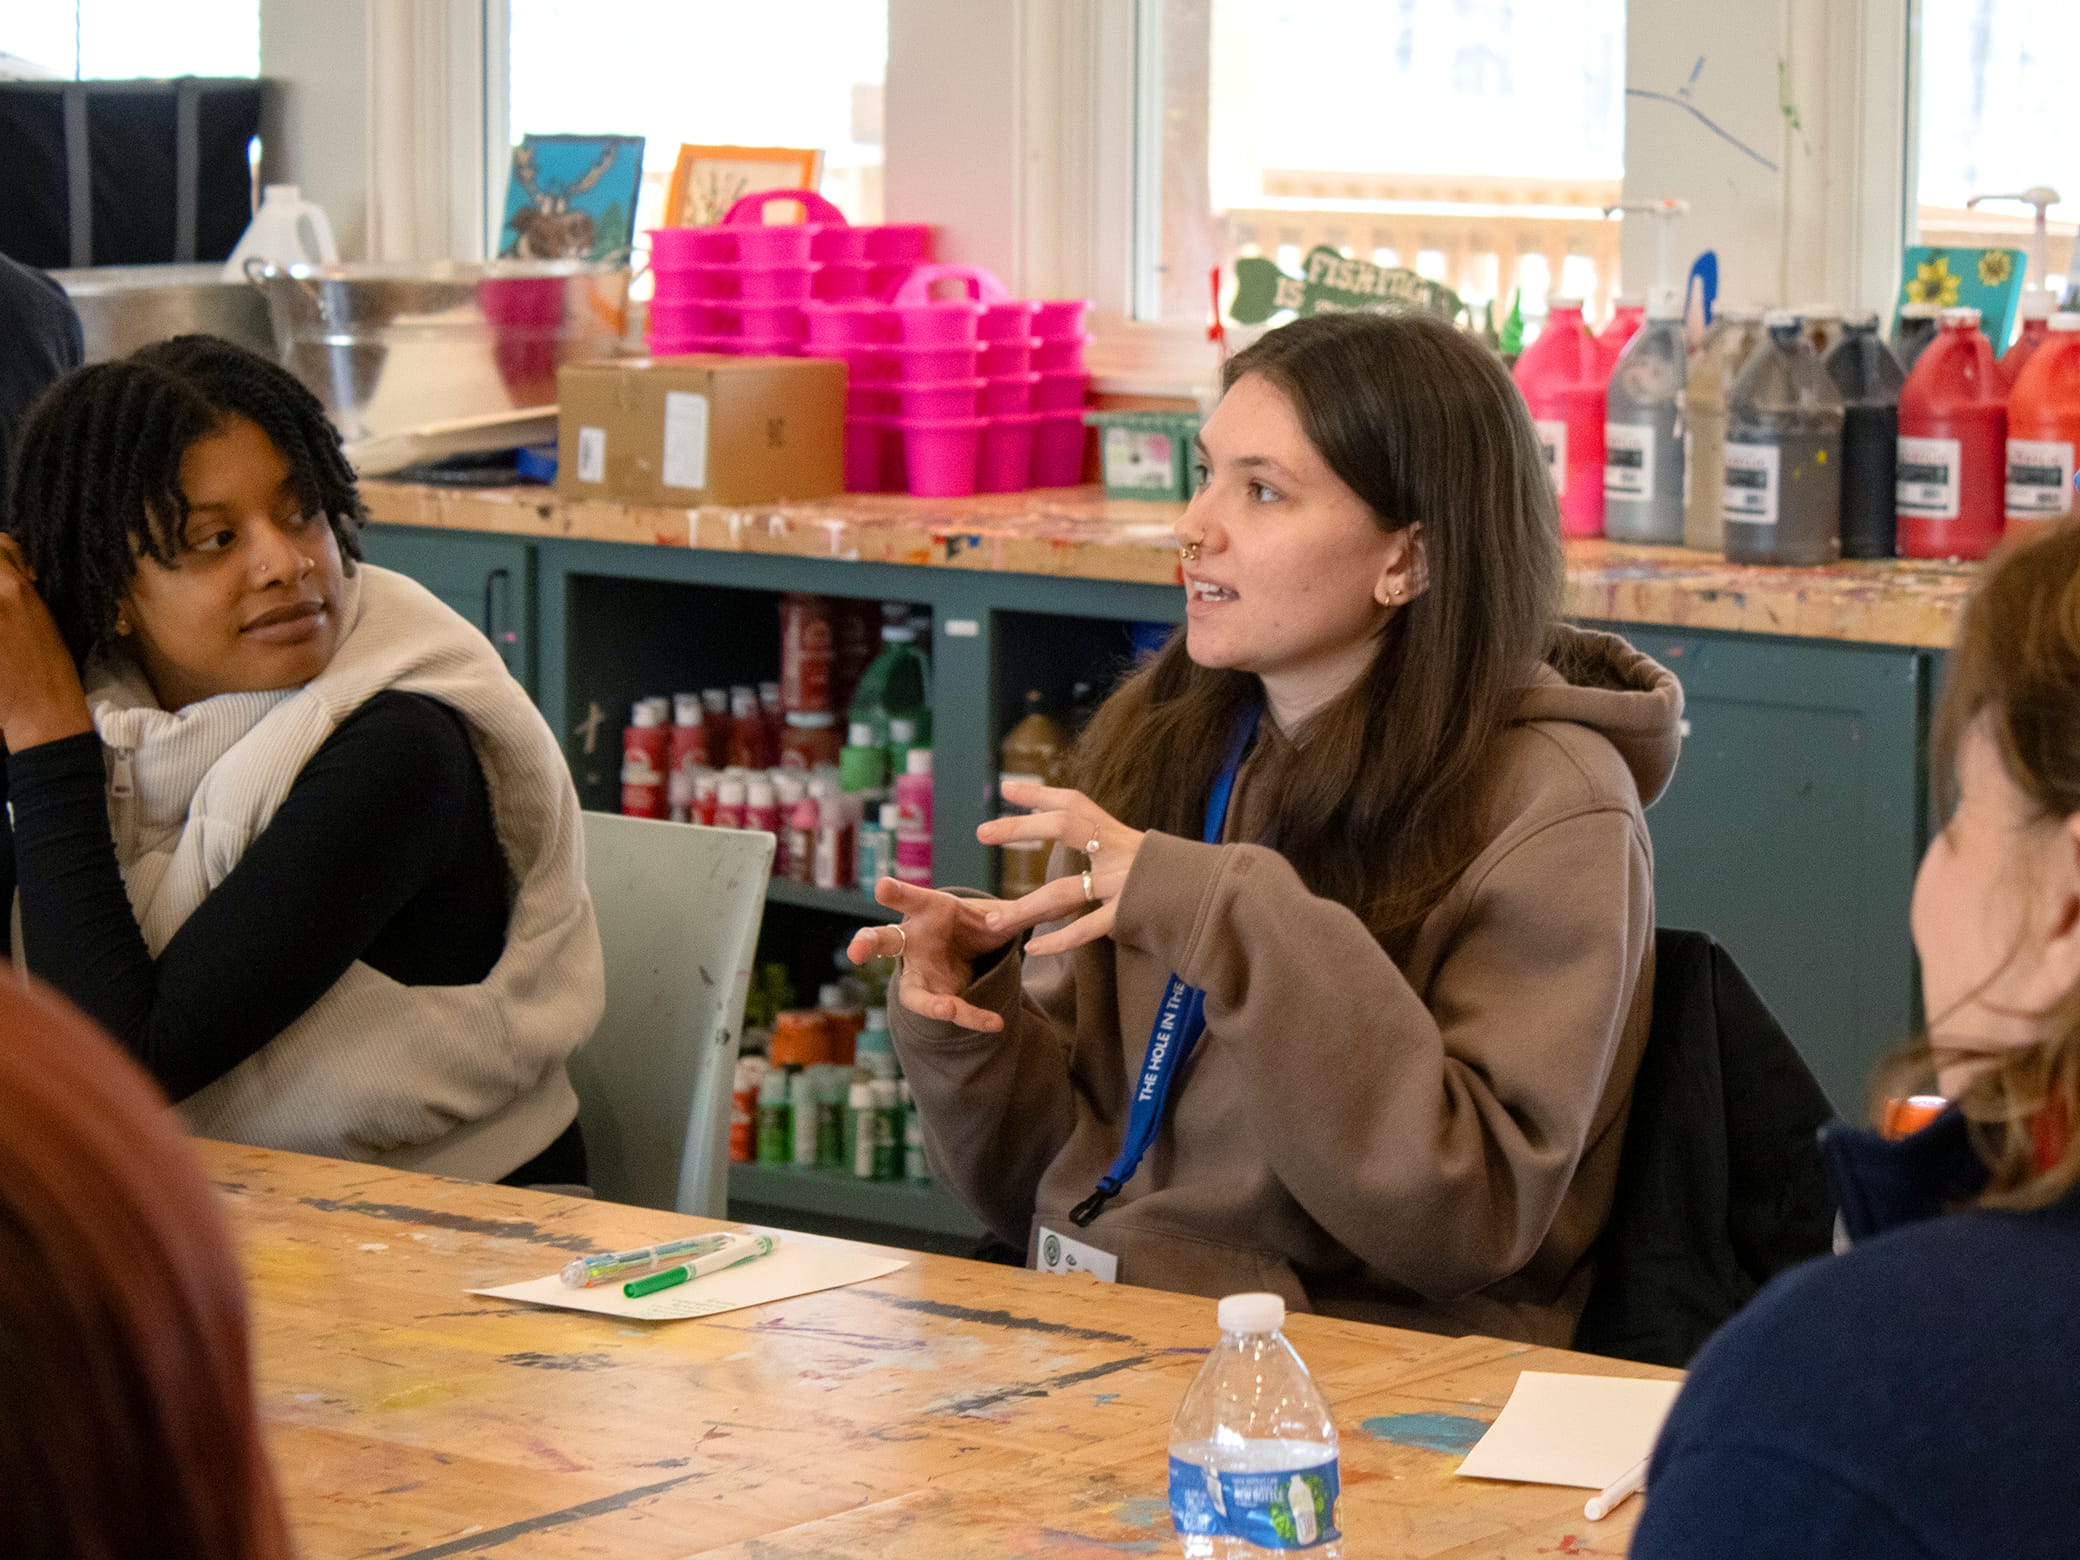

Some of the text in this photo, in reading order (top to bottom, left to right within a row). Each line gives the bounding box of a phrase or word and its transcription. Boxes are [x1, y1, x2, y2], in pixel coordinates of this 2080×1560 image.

[1274, 277, 1305, 308] IS
[1139, 981, 1185, 1101] THE HOLE IN THE
